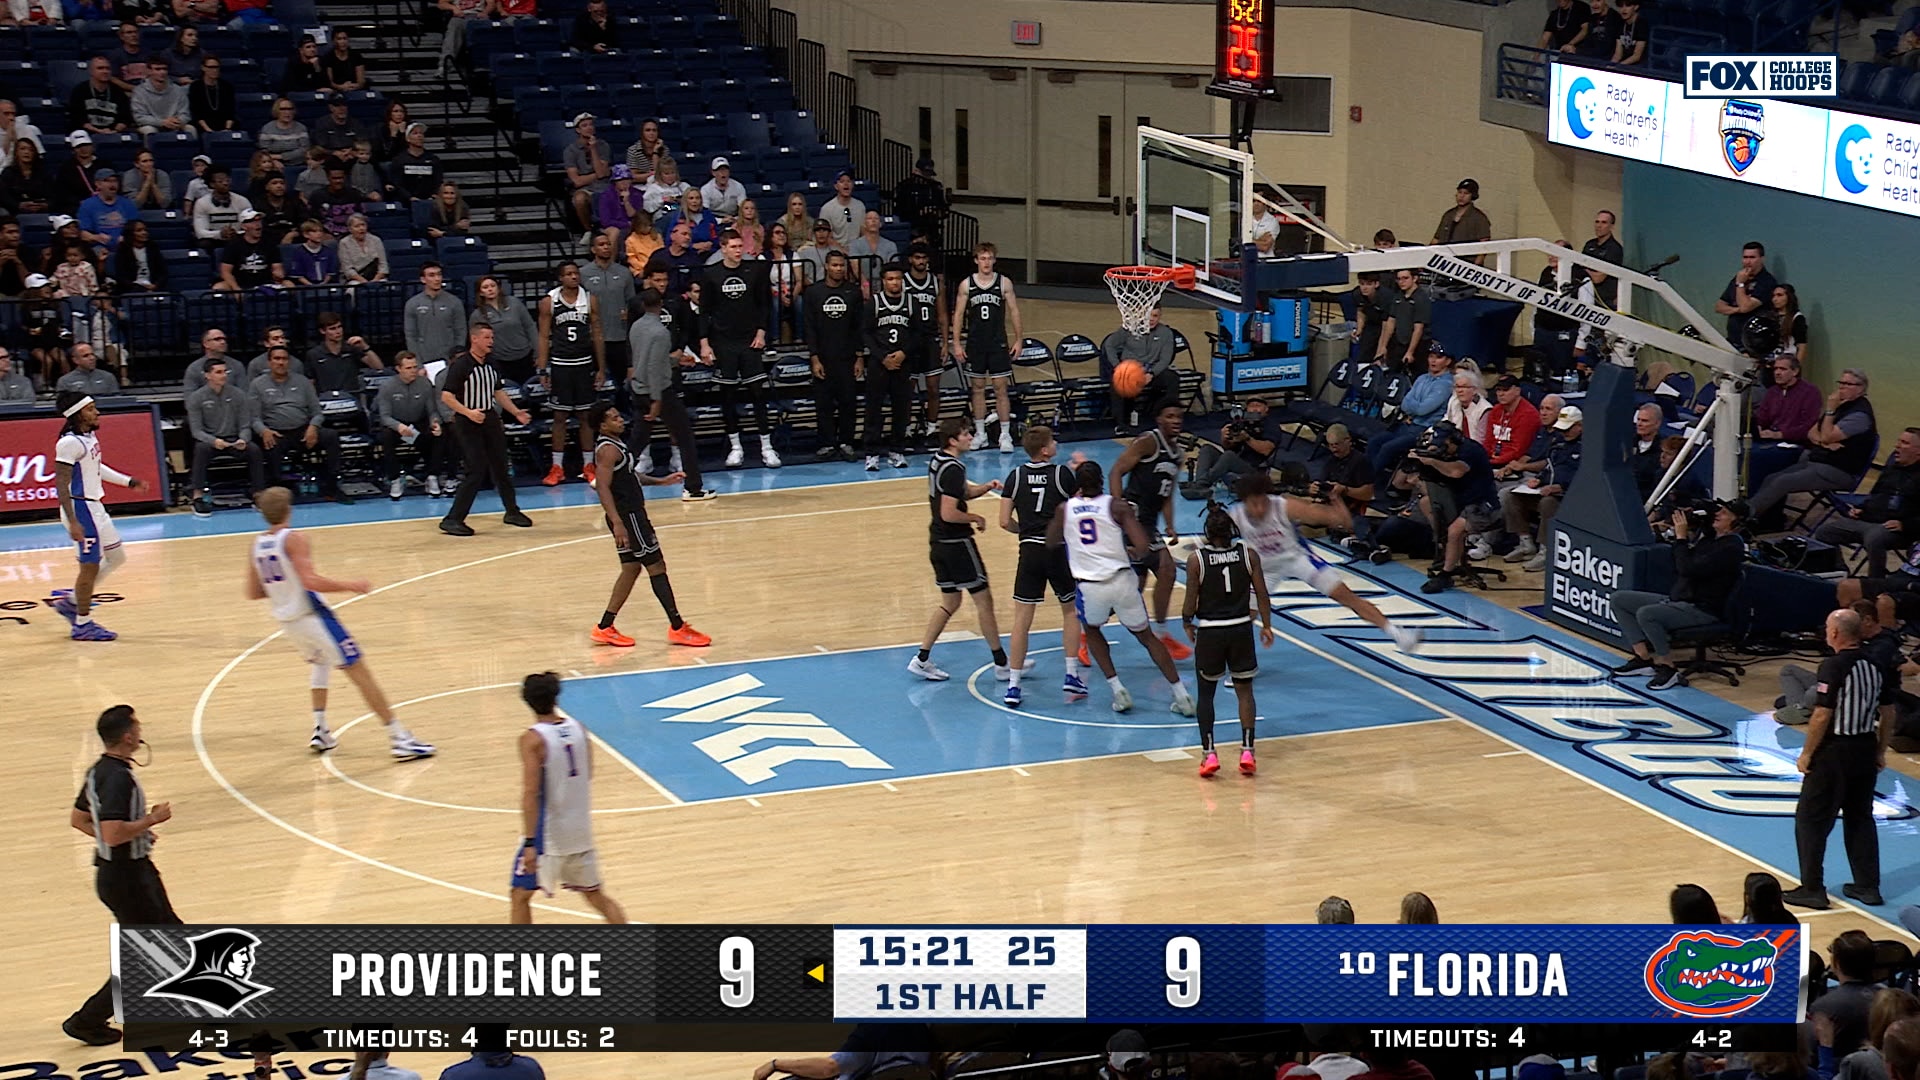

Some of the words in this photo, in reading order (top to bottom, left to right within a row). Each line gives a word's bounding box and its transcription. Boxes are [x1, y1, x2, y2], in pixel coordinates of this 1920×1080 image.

[1606, 83, 1635, 106] Rady
[1604, 131, 1639, 148] Health
[1886, 133, 1920, 159] Rady
[1884, 158, 1920, 181] Child
[1427, 254, 1516, 293] UNIVERSITY
[1517, 287, 1537, 301] OF
[1538, 292, 1573, 314] SAN
[1570, 303, 1612, 327] DIEGO
[555, 311, 588, 325] PROVIDENCE
[921, 306, 929, 321] 0
[980, 305, 990, 319] 8
[567, 326, 577, 341] 5
[888, 328, 899, 343] 3
[1237, 364, 1301, 379] POWERADE
[1027, 474, 1047, 485] VAAKS
[6, 487, 59, 501] RESOR
[1031, 488, 1046, 512] 7
[1079, 518, 1098, 545] 9
[1209, 551, 1240, 565] EDWARDS
[1554, 529, 1623, 589] Baker
[1222, 566, 1232, 593] 1
[565, 744, 579, 777] 1
